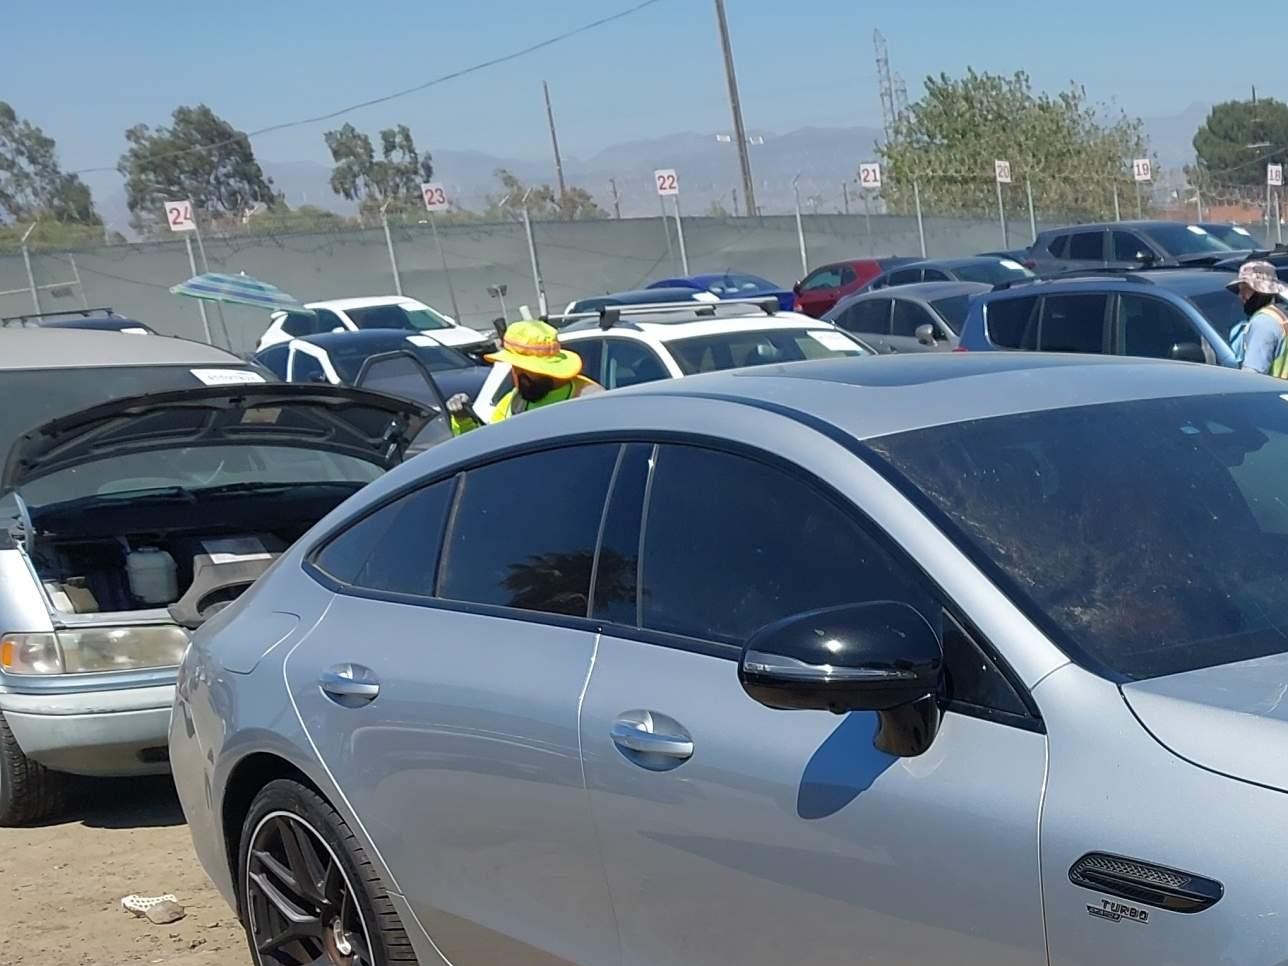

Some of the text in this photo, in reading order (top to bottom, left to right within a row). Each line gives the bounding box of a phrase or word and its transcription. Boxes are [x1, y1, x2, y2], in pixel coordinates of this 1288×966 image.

[861, 168, 880, 183] 21
[997, 165, 1009, 178] 20
[1135, 163, 1150, 177] 19
[1268, 169, 1281, 182] 18
[656, 174, 678, 190] 22
[424, 187, 446, 205] 23
[1101, 899, 1150, 921] TURBO
